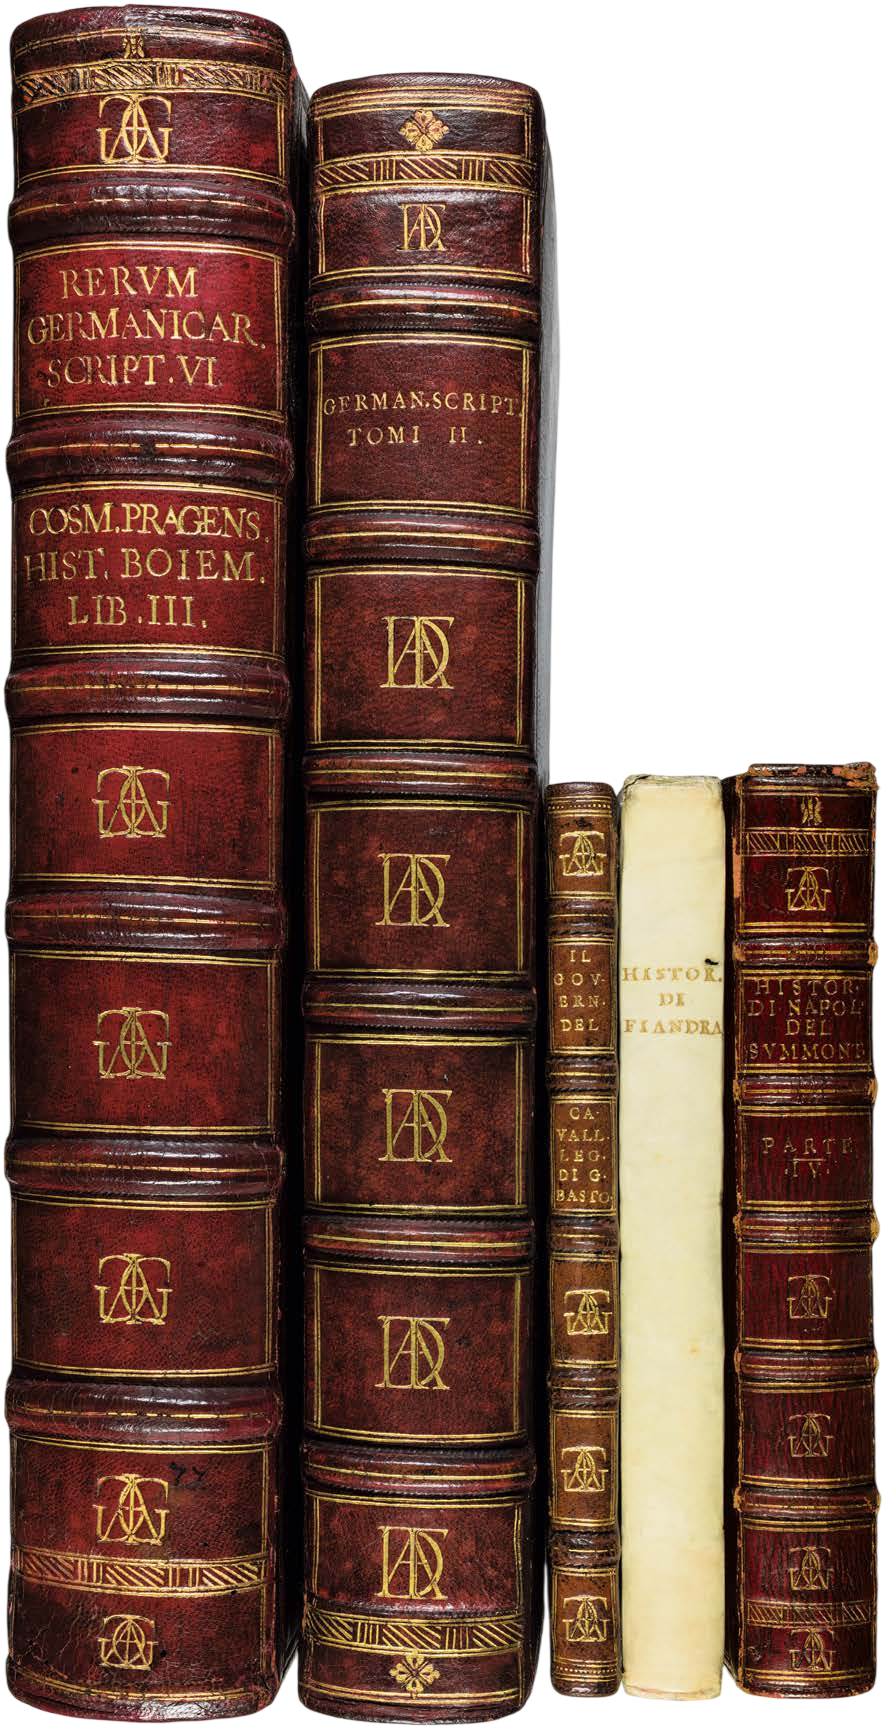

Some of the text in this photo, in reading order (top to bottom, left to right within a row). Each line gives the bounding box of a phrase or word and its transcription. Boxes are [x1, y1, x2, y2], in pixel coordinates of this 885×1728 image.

[60, 266, 198, 299] RERVM
[27, 307, 266, 349] GERMANICAR.
[348, 425, 483, 446] TOMI II.
[570, 949, 592, 963] IL
[559, 995, 606, 1008] ERN.
[658, 992, 686, 1007] DI
[747, 1000, 777, 1017] DI
[560, 1018, 600, 1032] DEL
[785, 1019, 832, 1036] DEL
[560, 1149, 606, 1162] LEG.
[559, 1168, 607, 1182] DI G.
